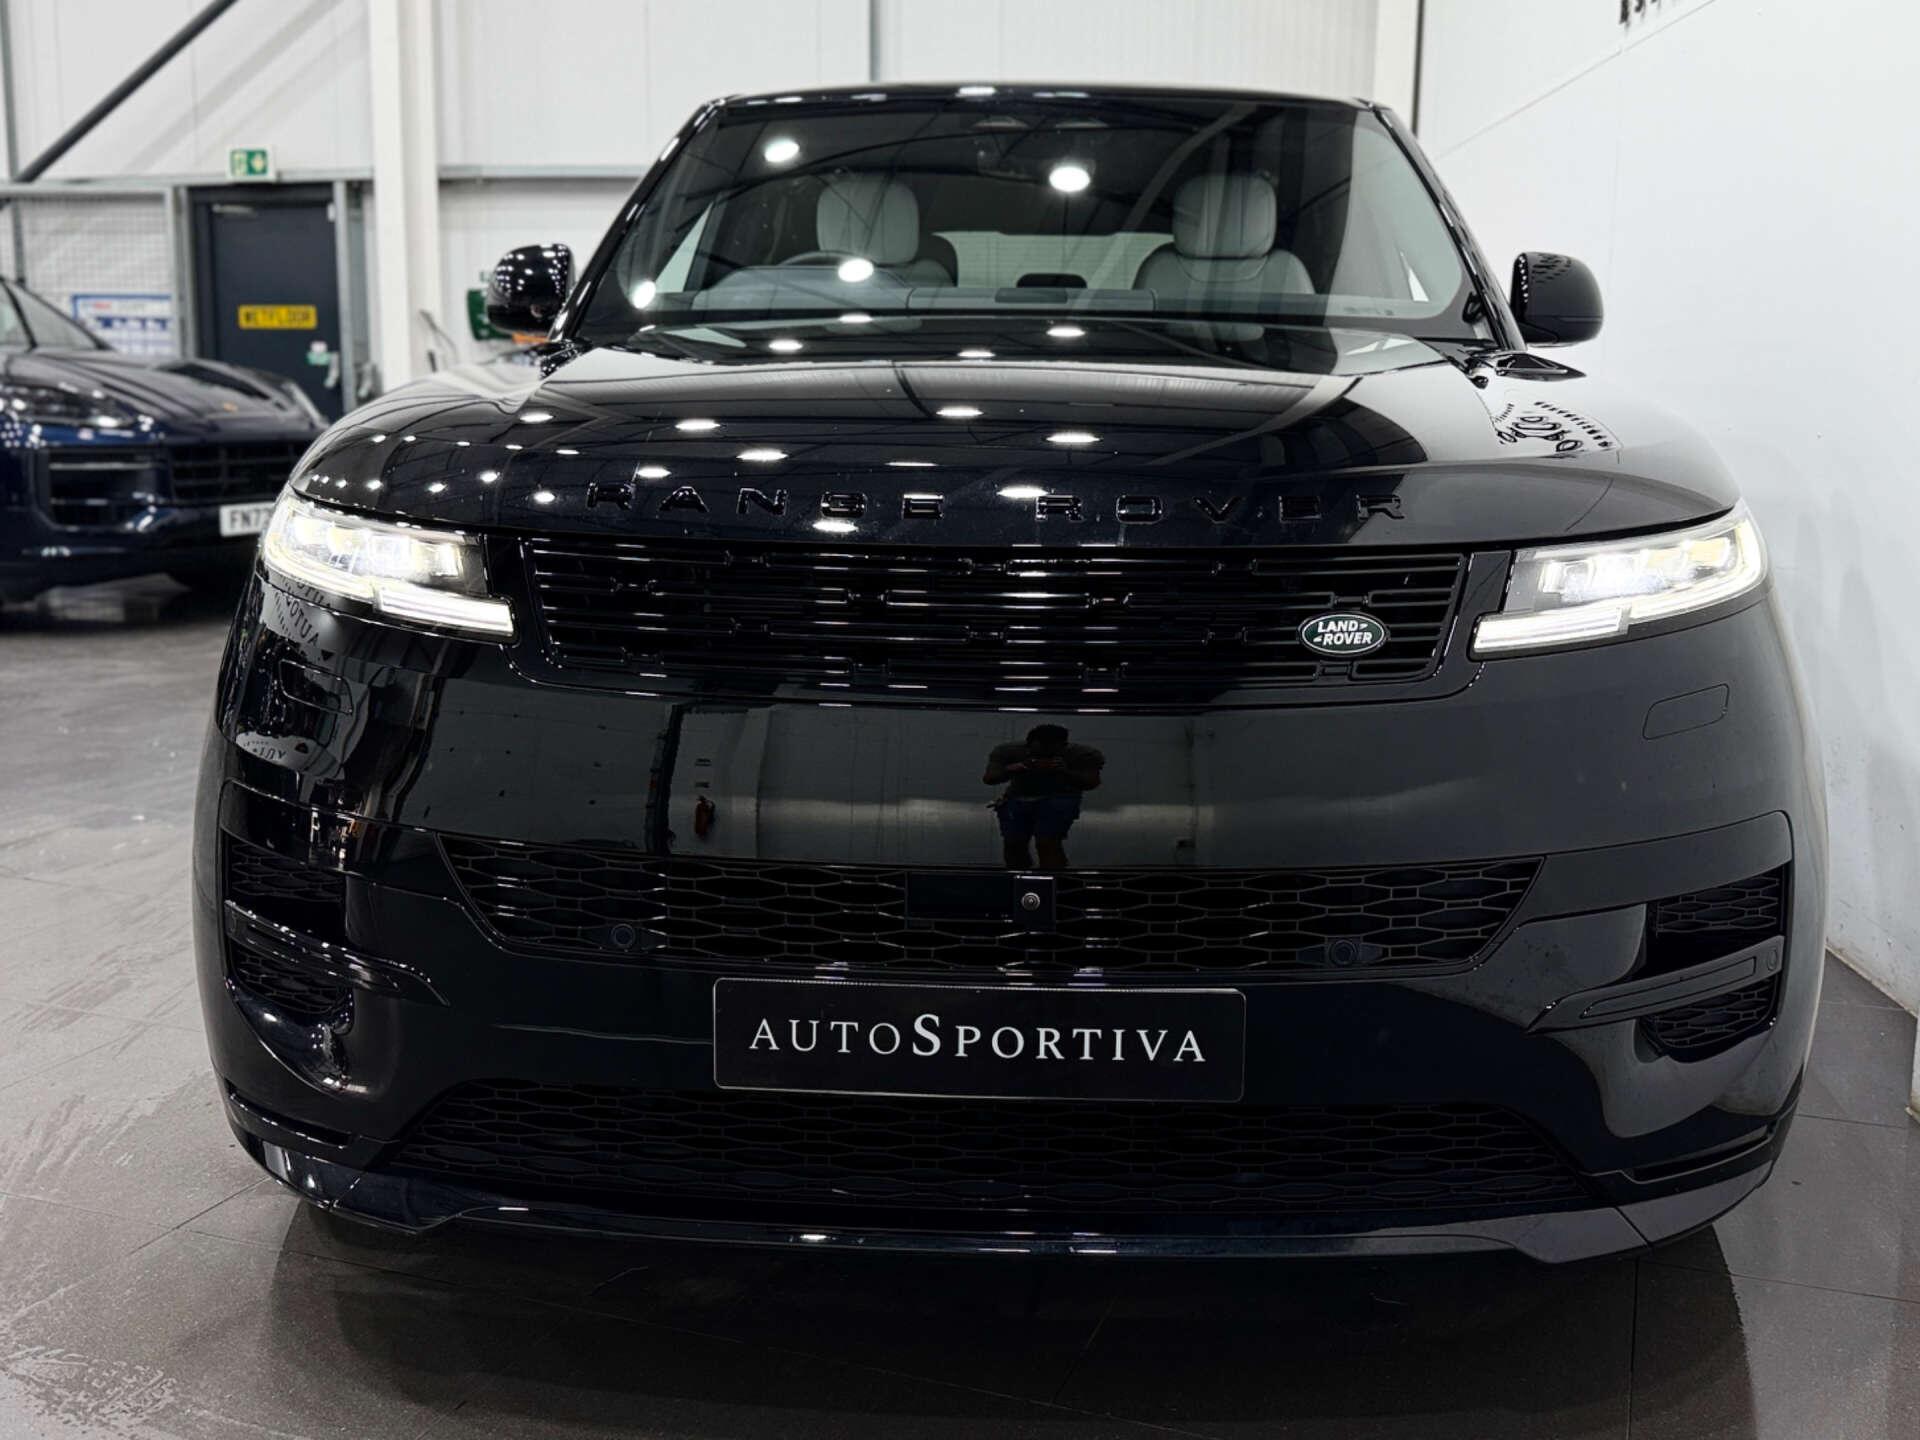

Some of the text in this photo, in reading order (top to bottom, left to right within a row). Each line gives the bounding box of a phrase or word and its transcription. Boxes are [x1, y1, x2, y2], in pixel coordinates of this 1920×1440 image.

[586, 480, 1404, 524] RANGE ROVER
[1317, 620, 1359, 633] LAND
[1322, 632, 1373, 646] ROVER
